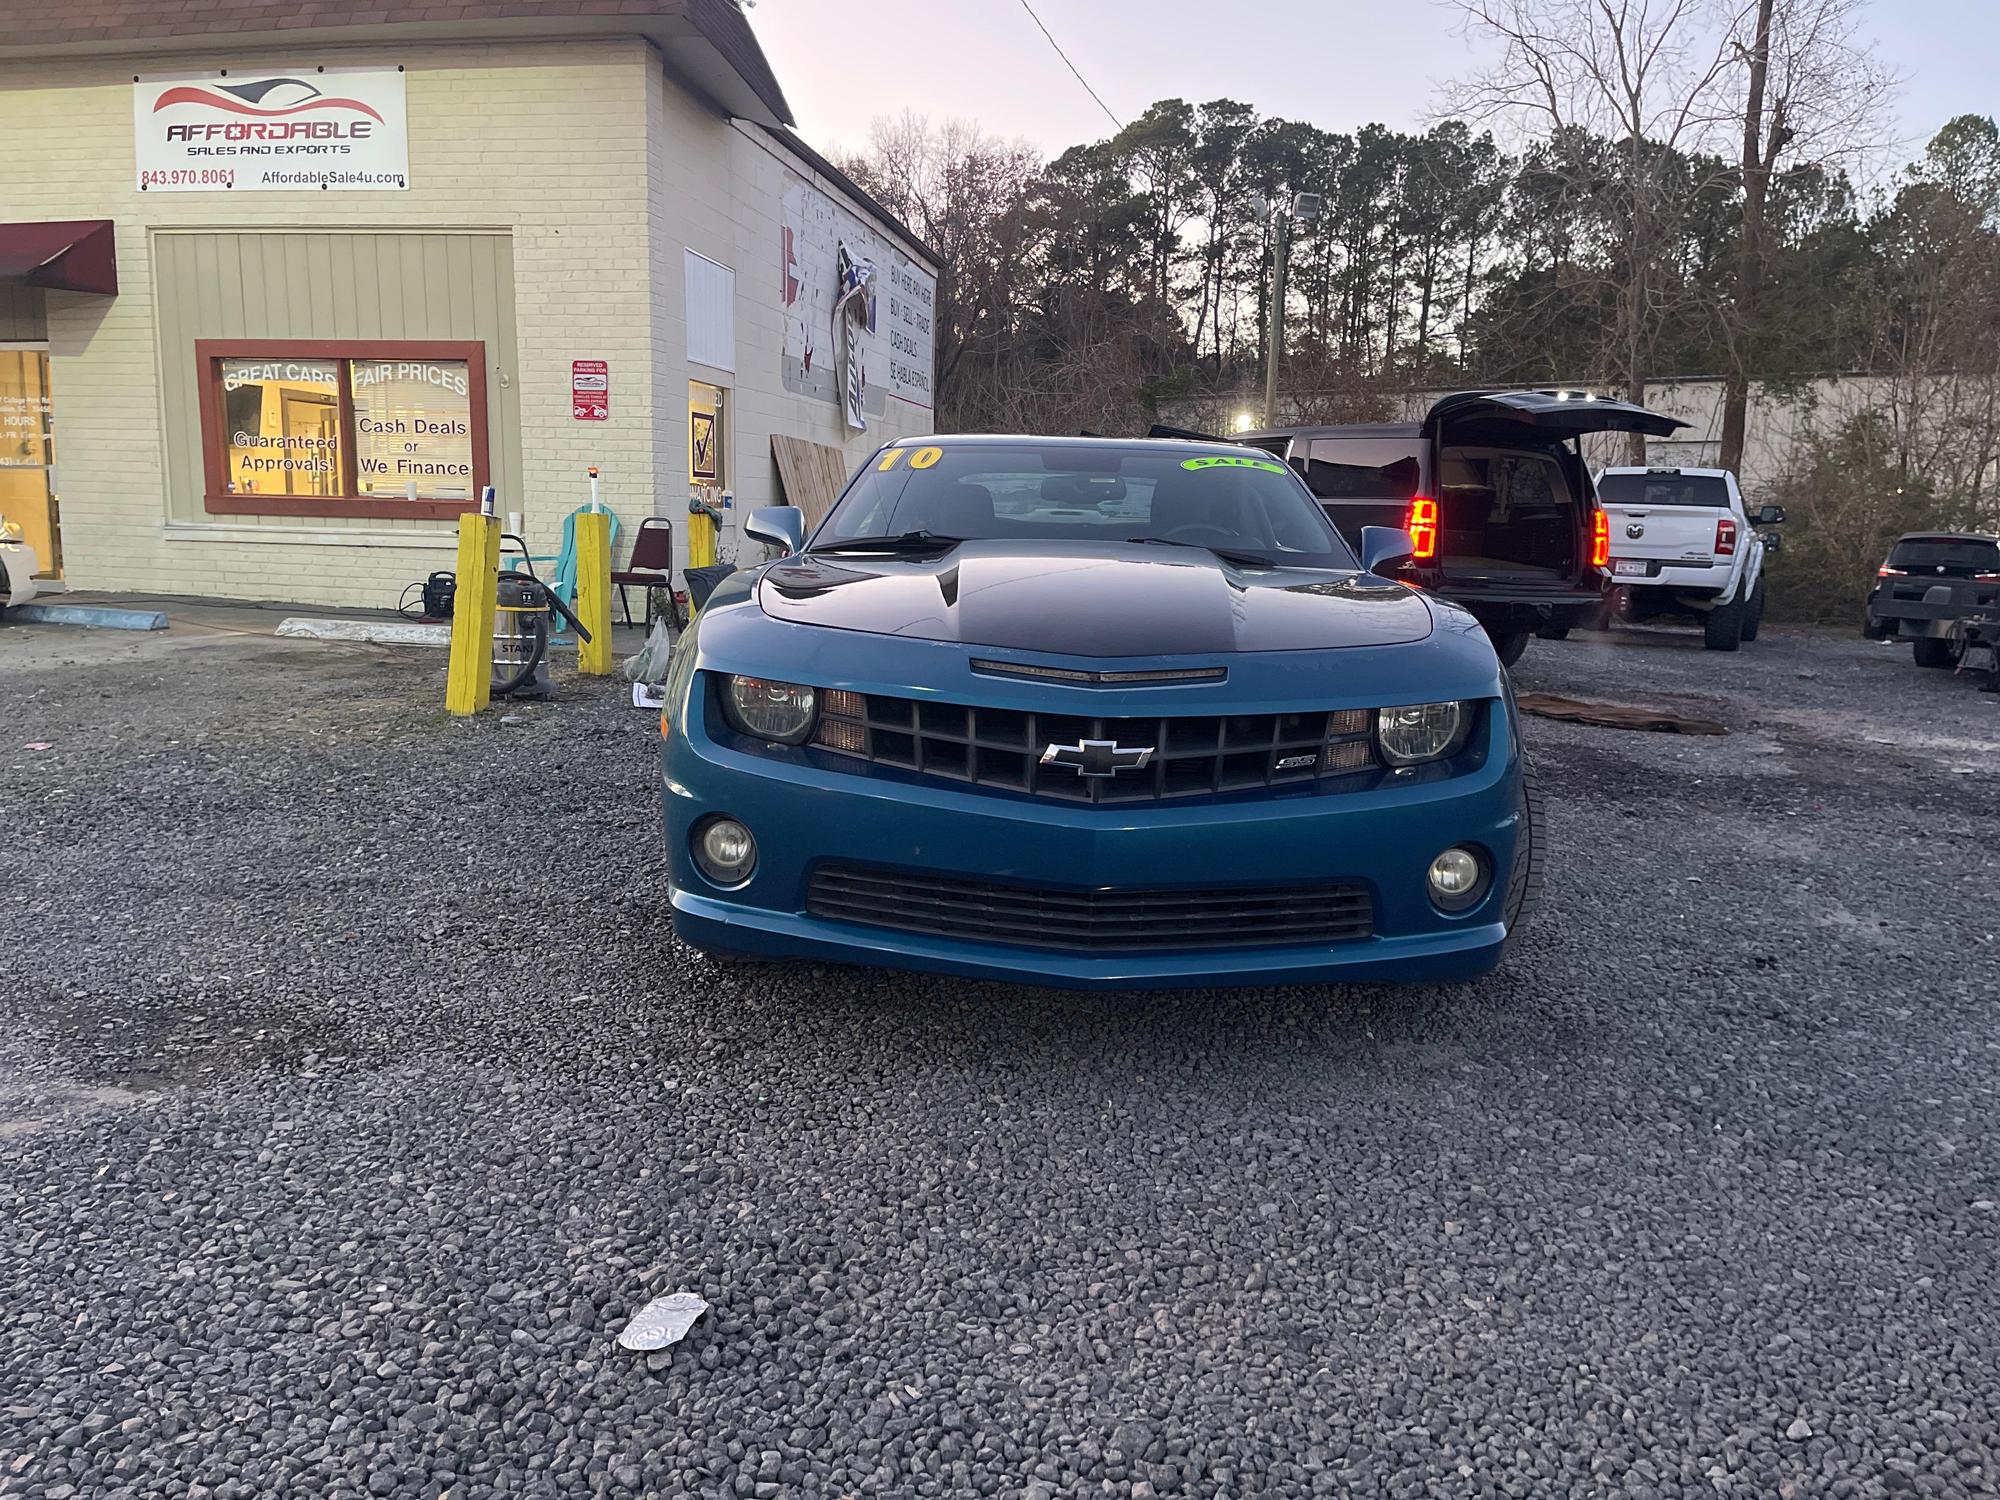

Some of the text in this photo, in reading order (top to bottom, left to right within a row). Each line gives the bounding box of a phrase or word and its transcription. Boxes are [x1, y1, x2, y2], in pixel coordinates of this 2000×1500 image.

[167, 121, 372, 143] AFFORDABLE
[187, 145, 351, 156] SALES AND EXPORTS
[142, 169, 405, 185] 843.970.8061 AffordableSale4u.com
[225, 363, 337, 392] GREAT CARS
[354, 363, 467, 397] FAIR PRICES
[4, 416, 36, 426] HOURS
[359, 418, 467, 435] Cash Deals
[234, 431, 337, 450] Guaranteed
[404, 441, 419, 452] or
[241, 456, 335, 473] Approvals!
[361, 459, 470, 476] We Finance
[878, 447, 943, 471] 10
[502, 644, 534, 653] STAN
[1275, 754, 1318, 769] SS
